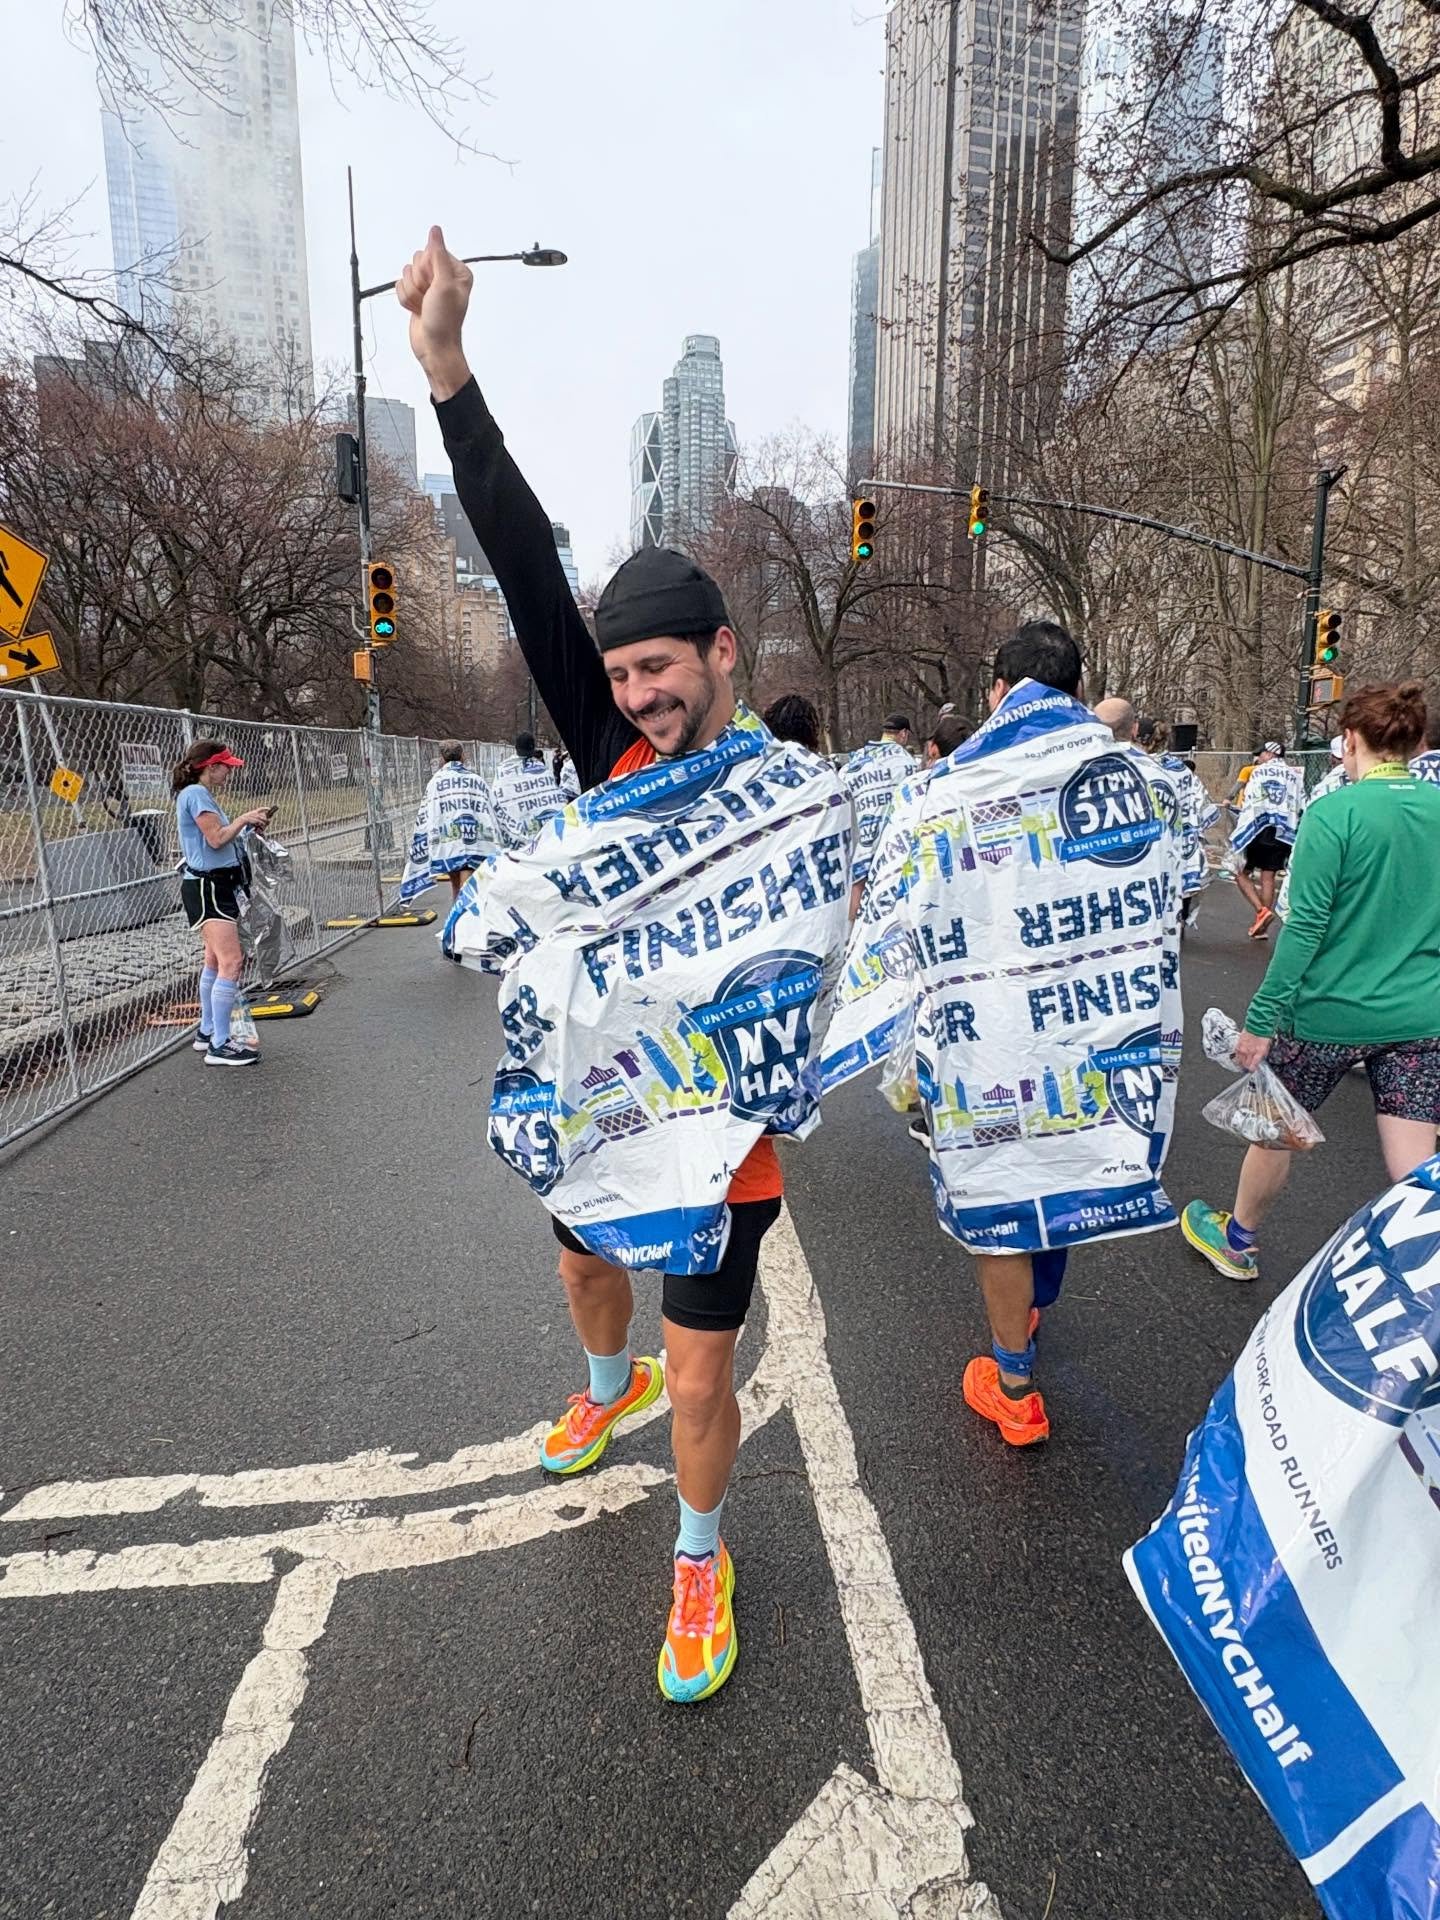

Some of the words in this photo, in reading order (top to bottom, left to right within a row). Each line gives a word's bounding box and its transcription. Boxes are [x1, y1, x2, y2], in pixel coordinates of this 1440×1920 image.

[123, 745, 160, 766] NATIONAL
[692, 740, 751, 774] UNITED
[518, 793, 568, 812] FINISHE
[596, 778, 667, 815] AIRLINES
[1077, 769, 1135, 800] HALF
[1074, 791, 1146, 834] NYC
[1067, 836, 1121, 855] AIRLINES
[582, 829, 852, 998] FINISHE
[1014, 872, 1169, 949] ISHER
[702, 1000, 757, 1025] UNITED
[733, 1007, 811, 1071] NY
[1101, 1052, 1147, 1065] UNITED
[740, 1057, 804, 1104] HA
[1067, 1209, 1150, 1233] AIRLINES
[1080, 1197, 1147, 1219] UNITED
[1331, 1227, 1438, 1382] HALF
[1255, 1349, 1271, 1394] YORK
[1261, 1392, 1288, 1452] ROAD
[1280, 1456, 1343, 1570] RUNNERS
